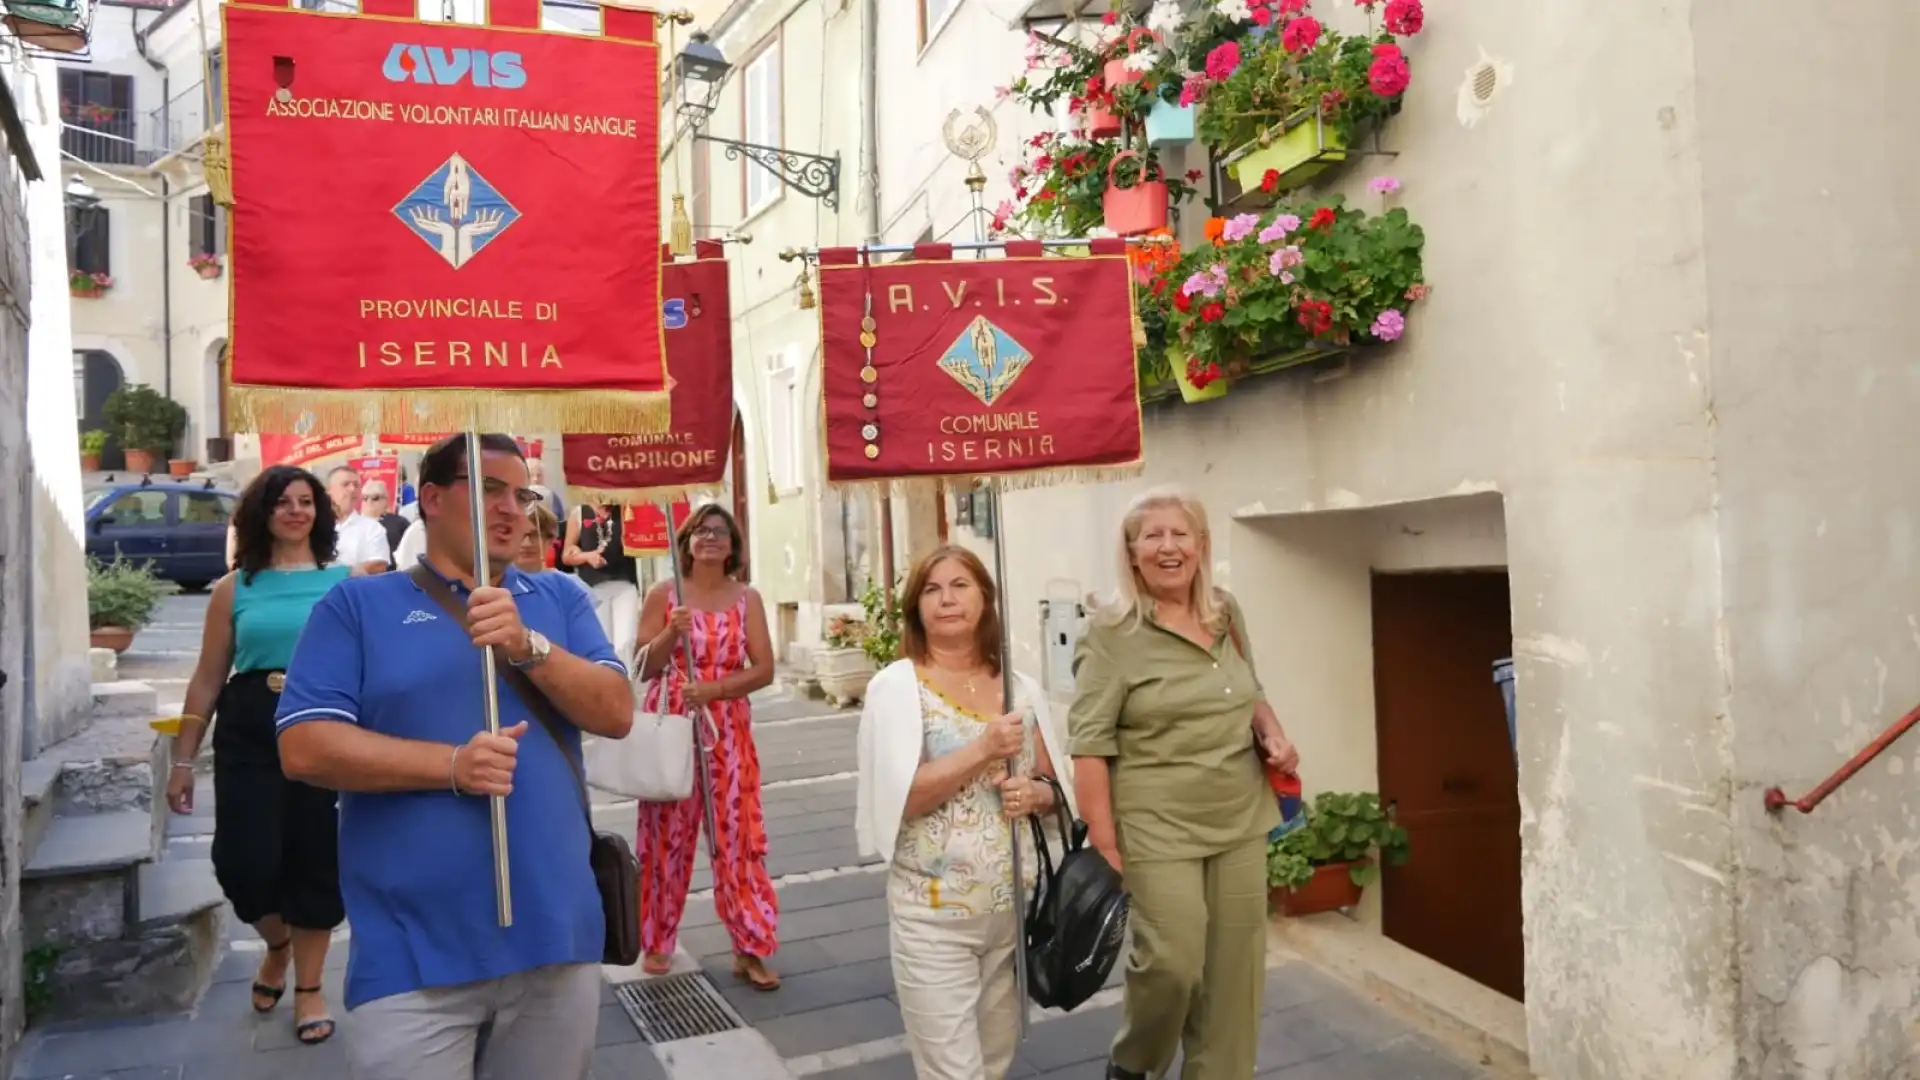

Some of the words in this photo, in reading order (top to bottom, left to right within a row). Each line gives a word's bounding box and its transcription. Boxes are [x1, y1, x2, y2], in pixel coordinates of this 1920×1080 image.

[382, 42, 527, 89] AVIS
[266, 97, 394, 121] ASSOCIAZIONE
[400, 104, 499, 127] VOLONTARI
[503, 108, 570, 131] ITALIANI
[574, 116, 637, 138] SANGUE
[360, 299, 523, 320] PROVINCIALE
[535, 302, 558, 322] DI
[359, 341, 563, 369] ISERNIA
[940, 411, 1040, 435] COMUNALE
[608, 432, 695, 448] COMUNALE
[929, 435, 1055, 463] ISERNIA
[587, 450, 717, 472] CARPINONE
